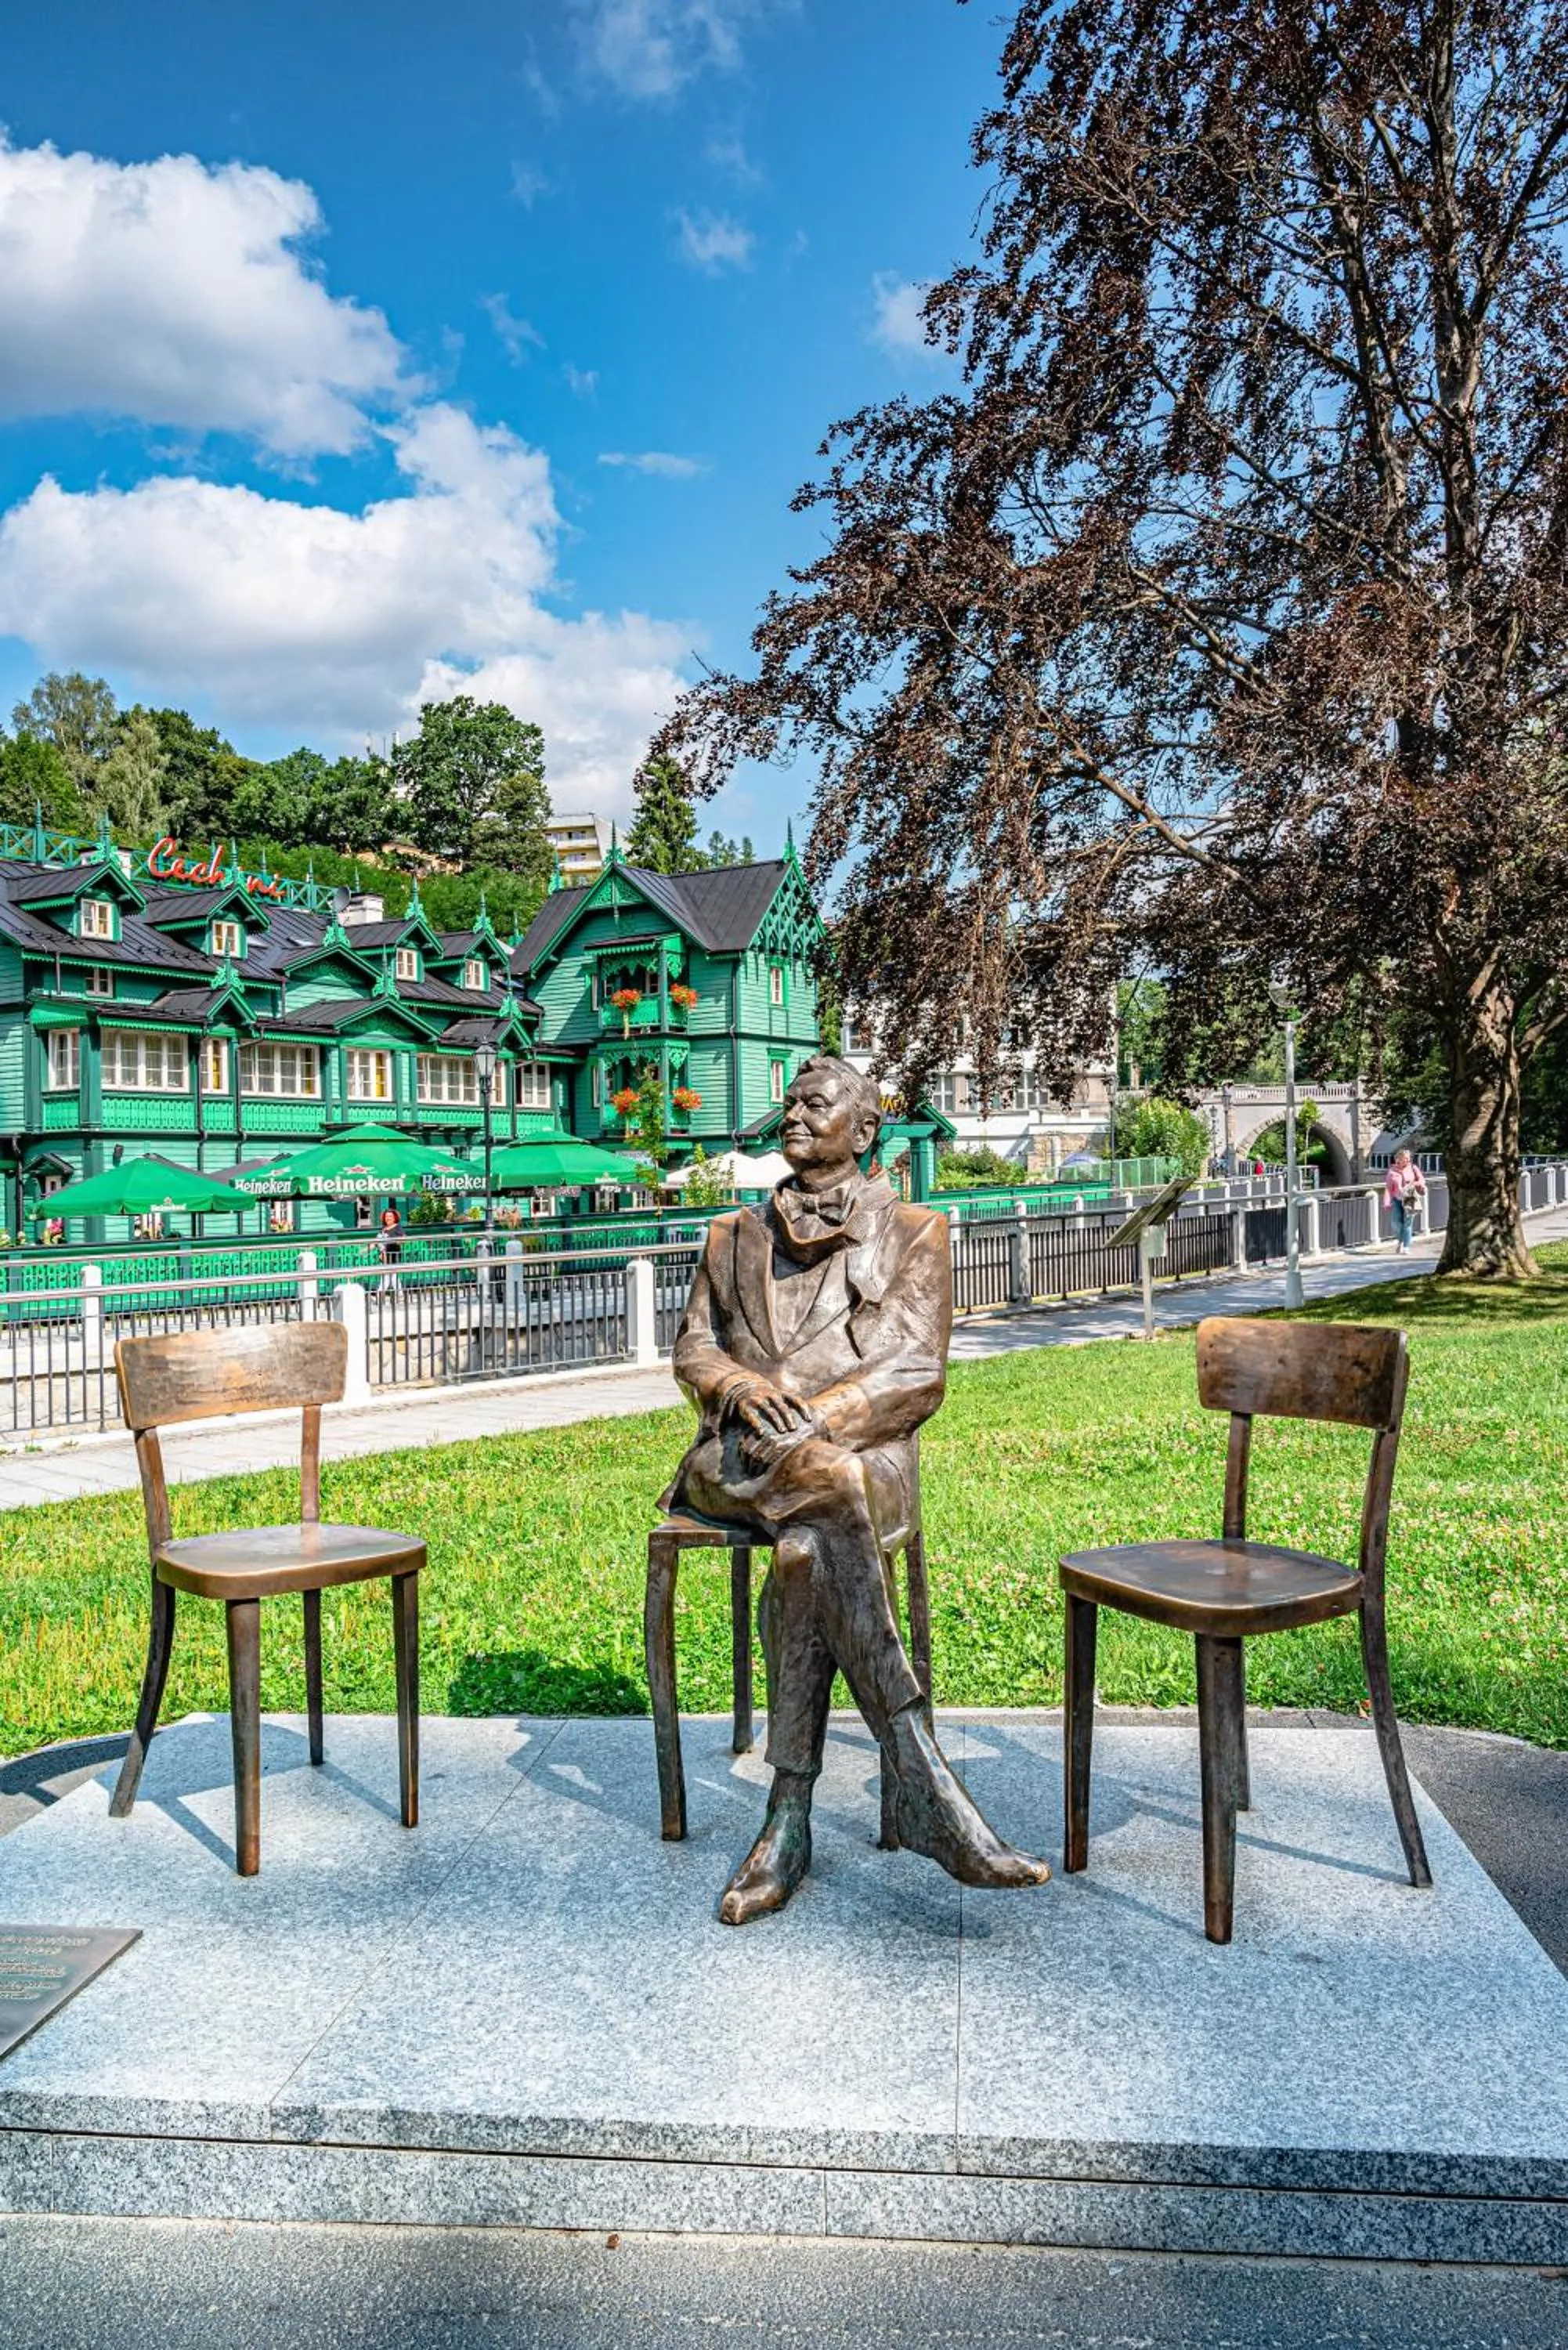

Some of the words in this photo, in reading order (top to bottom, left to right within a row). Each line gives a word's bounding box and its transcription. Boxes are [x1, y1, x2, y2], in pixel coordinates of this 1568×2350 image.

[148, 837, 287, 897] Cechni
[234, 1177, 291, 1194] Heineken
[308, 1175, 405, 1193] Heineken
